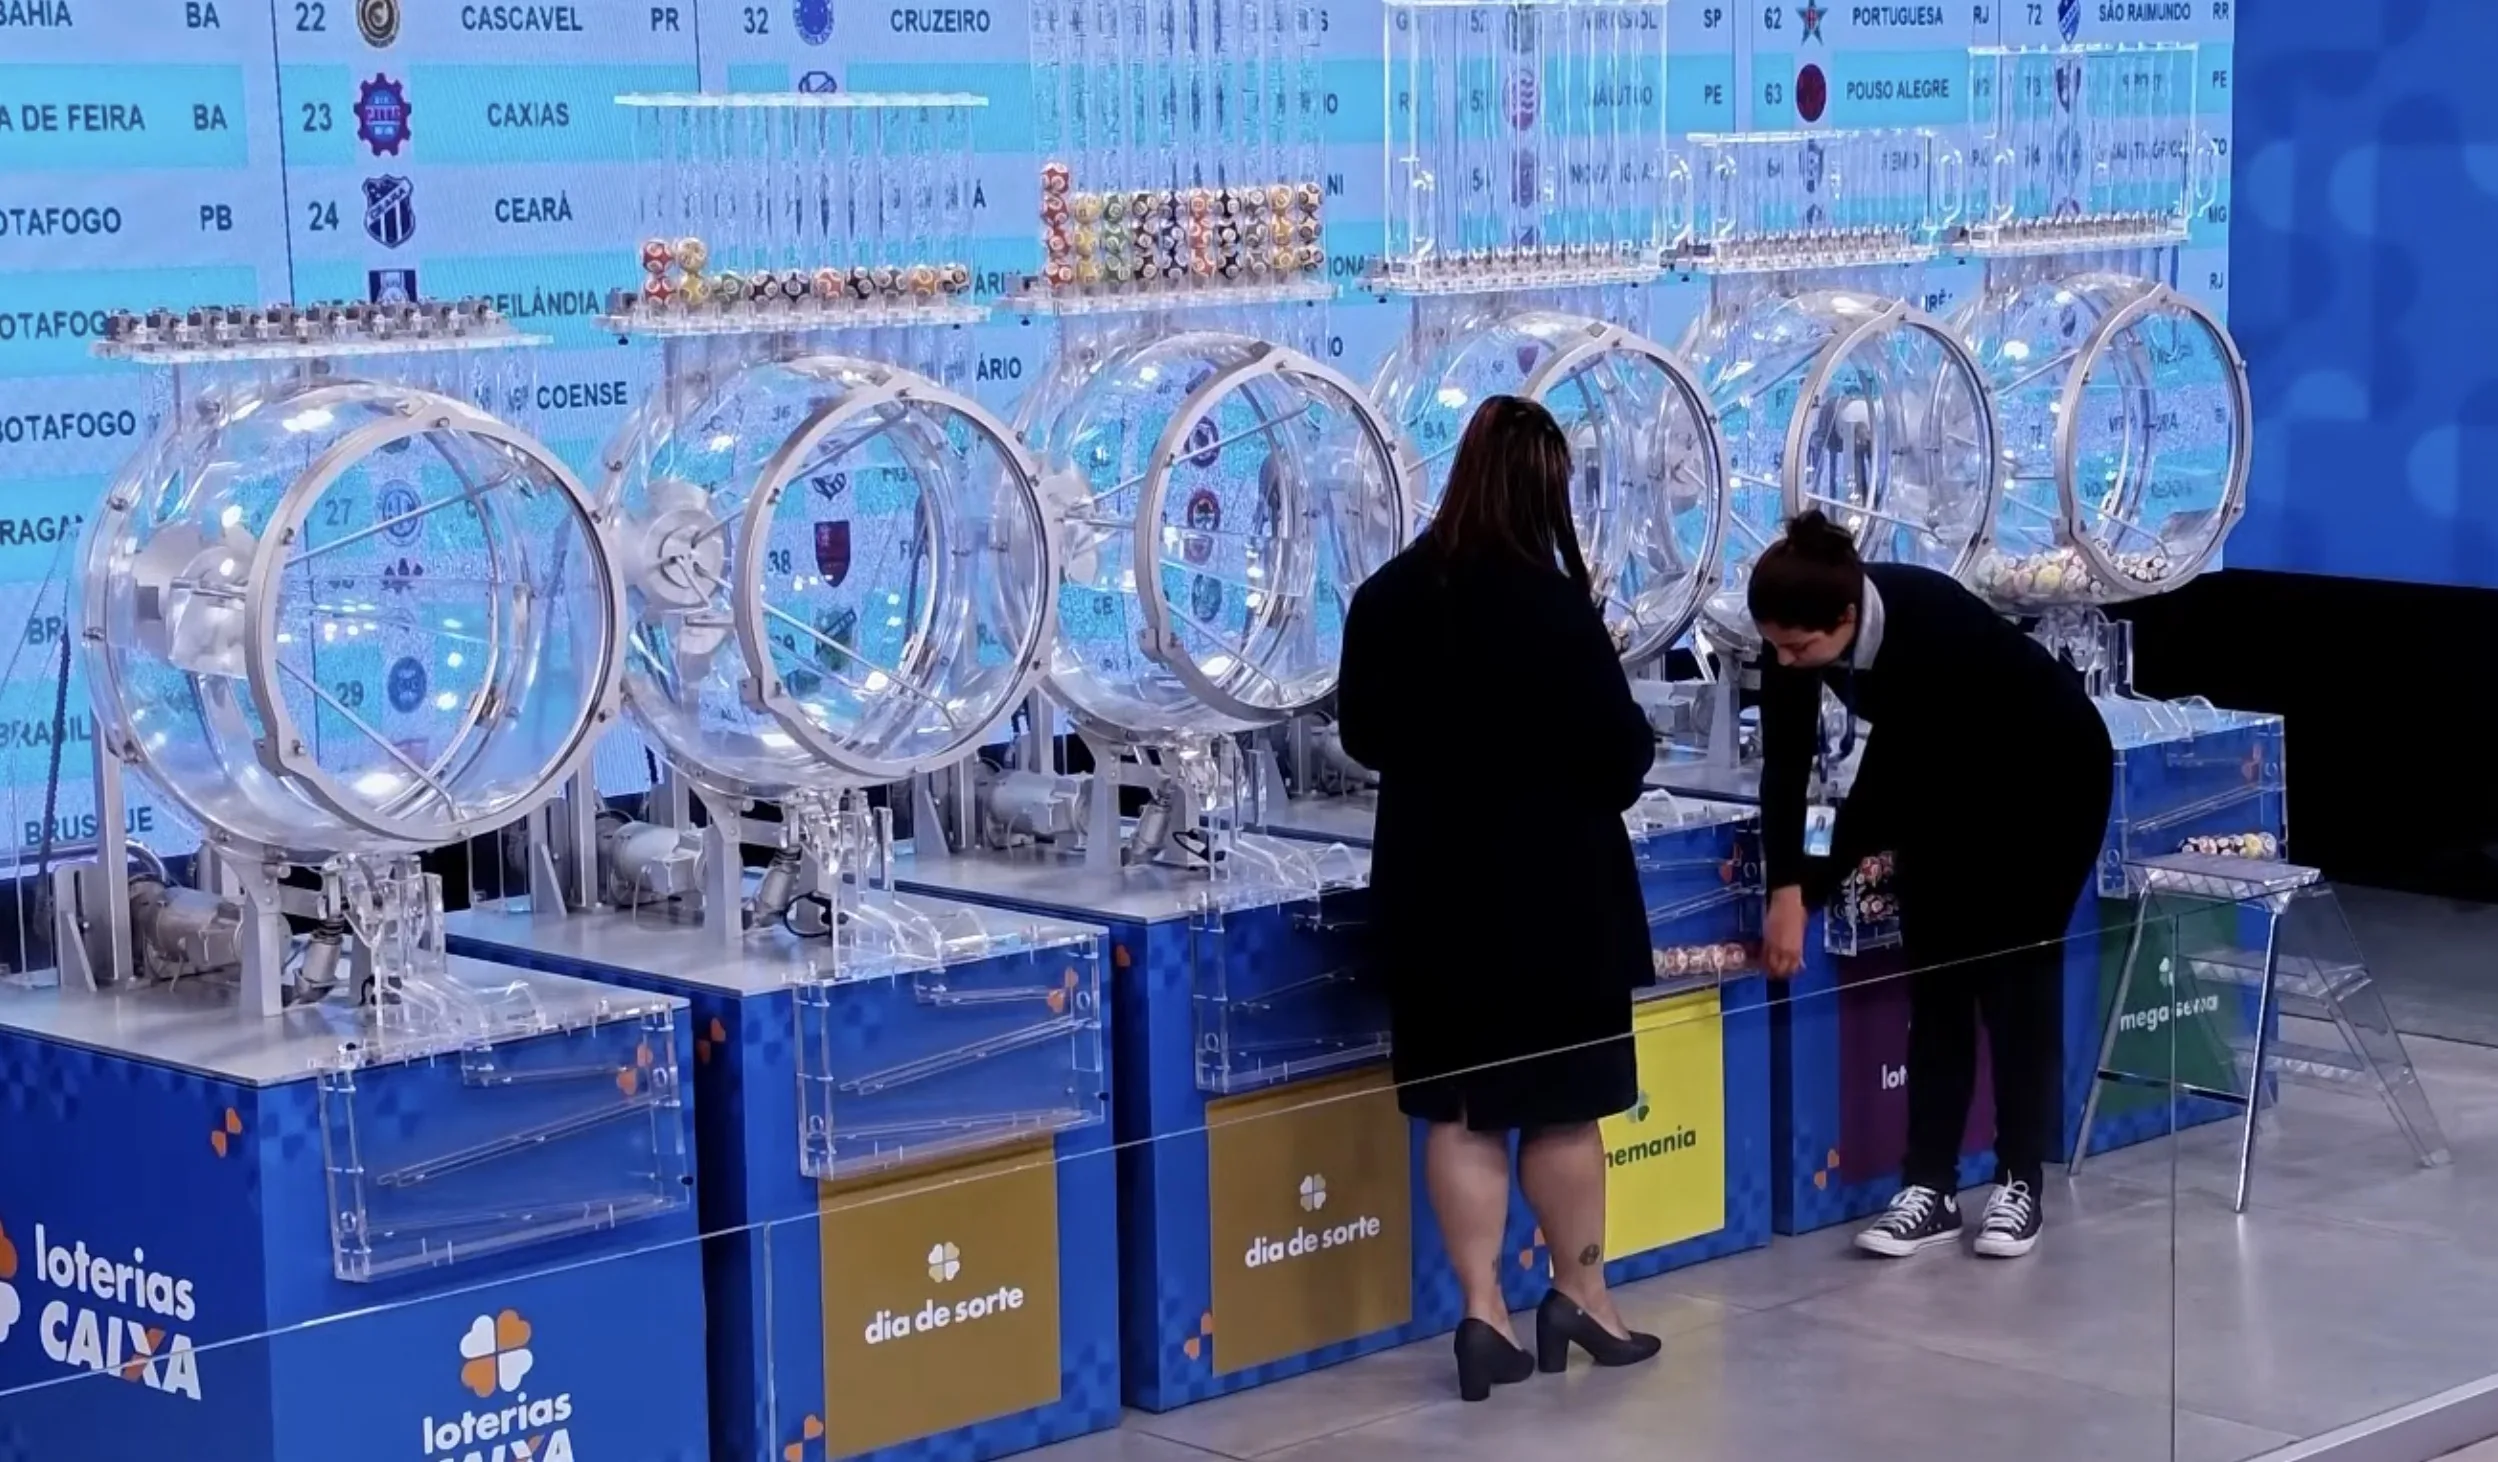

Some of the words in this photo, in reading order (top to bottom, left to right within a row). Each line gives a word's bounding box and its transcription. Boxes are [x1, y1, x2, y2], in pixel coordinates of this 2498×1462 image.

[186, 2, 220, 28] BA
[296, 5, 326, 31] 22
[462, 5, 583, 32] CASCAVEL
[651, 8, 680, 32] PR
[743, 9, 769, 34] 32
[890, 9, 991, 33] CRUZEIRO
[1704, 9, 1721, 28] SP
[1764, 11, 1782, 30] 62
[1852, 7, 1943, 26] PORTUGUESA
[1973, 6, 1989, 24] RJ
[2027, 4, 2042, 25] 72
[2099, 2, 2123, 22] SÃO
[2127, 3, 2191, 21] RAIMUNDO
[2212, 2, 2229, 20] RR
[1847, 81, 1893, 100] POUSO
[1896, 79, 1949, 98] ALEGRE
[2212, 70, 2227, 88] PE
[1704, 85, 1722, 104] PE
[1764, 83, 1782, 104] 63
[21, 104, 58, 131] DE
[67, 104, 146, 131] FEIRA
[193, 104, 228, 130] BA
[303, 102, 333, 132] 23
[487, 102, 570, 128] CAXIAS
[200, 204, 233, 231] PB
[308, 201, 339, 231] 24
[494, 190, 573, 223] CEARÁ
[0, 310, 108, 340] OTAFOG
[0, 409, 136, 445] OTAFOGO
[25, 806, 153, 846] BRUSUE
[1244, 1238, 1284, 1269] dia
[1288, 1227, 1318, 1255] de
[1322, 1214, 1381, 1249] sorte
[35, 1223, 195, 1322] loterias
[865, 1310, 910, 1345] dia
[915, 1299, 950, 1330] de
[954, 1285, 1024, 1325] sorte
[40, 1300, 202, 1400] CAIXA
[423, 1391, 572, 1454] loterias
